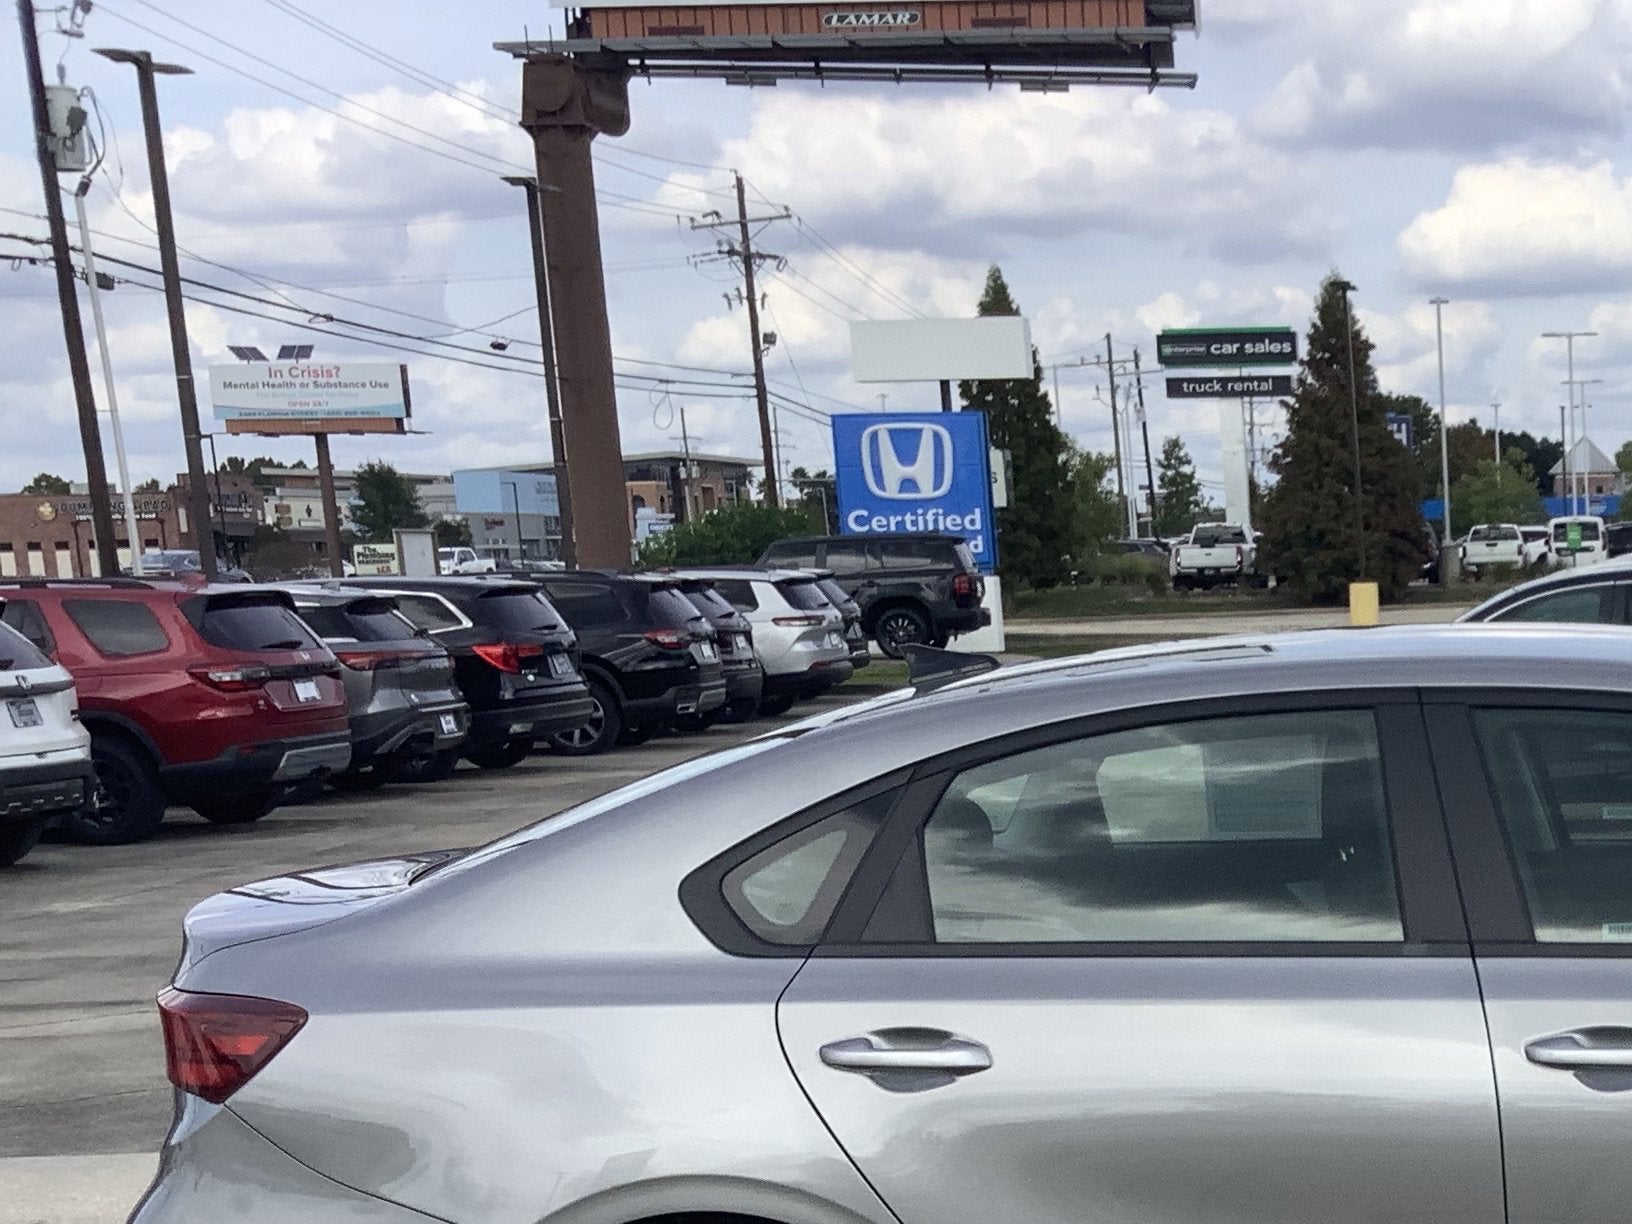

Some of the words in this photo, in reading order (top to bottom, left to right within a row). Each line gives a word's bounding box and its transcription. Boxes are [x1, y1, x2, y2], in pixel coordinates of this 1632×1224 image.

[831, 12, 912, 26] LAMAR
[1210, 341, 1241, 355] car
[1244, 338, 1293, 355] sales
[268, 366, 284, 379] In
[288, 365, 342, 379] Crisis?
[223, 380, 259, 390] Mental
[262, 380, 297, 390] Health
[299, 381, 310, 390] or
[313, 380, 367, 390] Substance
[369, 380, 390, 390] Use
[1182, 379, 1223, 393] truck
[1227, 378, 1273, 392] rental
[848, 508, 981, 532] Certified
